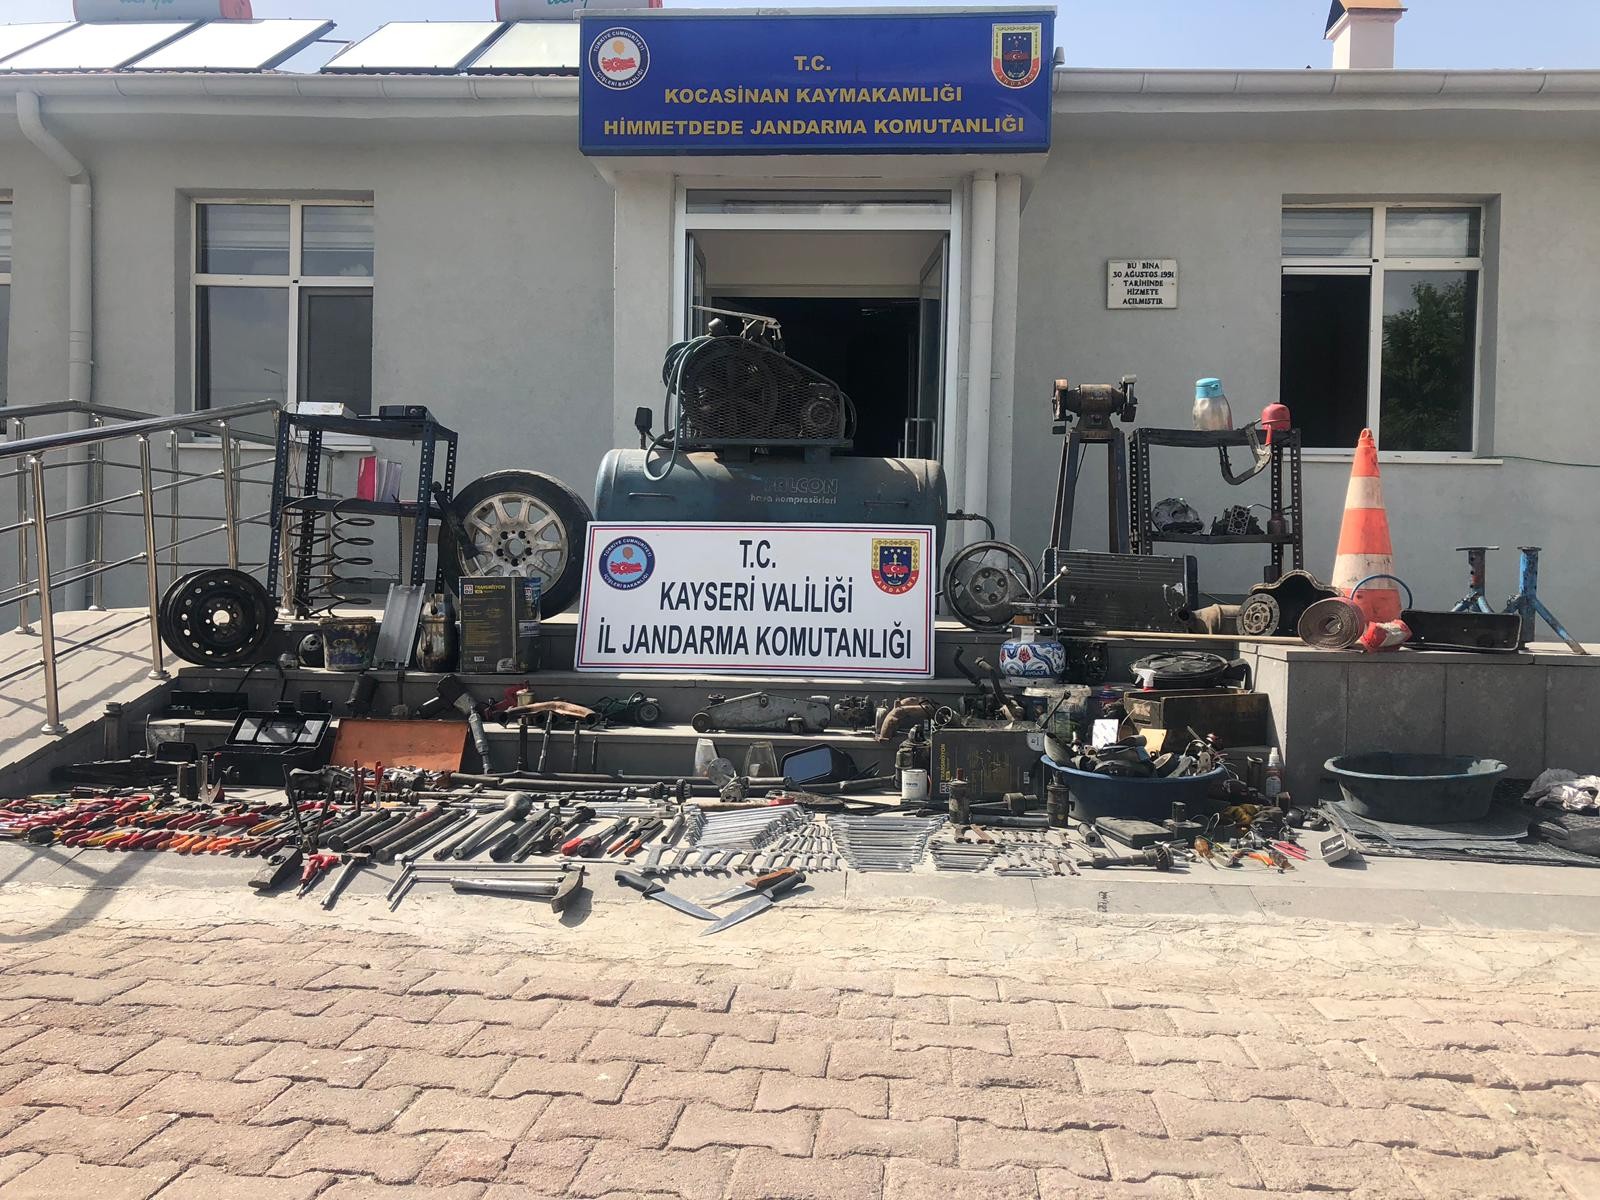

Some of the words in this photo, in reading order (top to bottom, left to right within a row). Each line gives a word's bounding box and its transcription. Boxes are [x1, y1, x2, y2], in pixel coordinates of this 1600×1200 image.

[793, 54, 832, 72] T.C.
[664, 84, 789, 104] KOCASİNAN
[796, 83, 962, 104] KAYMAKAMLIĞI
[603, 116, 744, 136] HİMMETDEDE
[750, 118, 867, 135] JANDARMA
[874, 114, 1025, 134] KOMUTANLIĞI
[1124, 270, 1158, 278] AĞUSTOS
[1142, 261, 1160, 269] BİNA
[739, 540, 776, 568] T.C.
[660, 576, 755, 611] KAYSERİ
[762, 576, 853, 613] VALİLİĞİ
[597, 617, 616, 654] İL
[622, 624, 749, 655] JANDARMA
[755, 621, 911, 659] KOMUTANLIĞI
